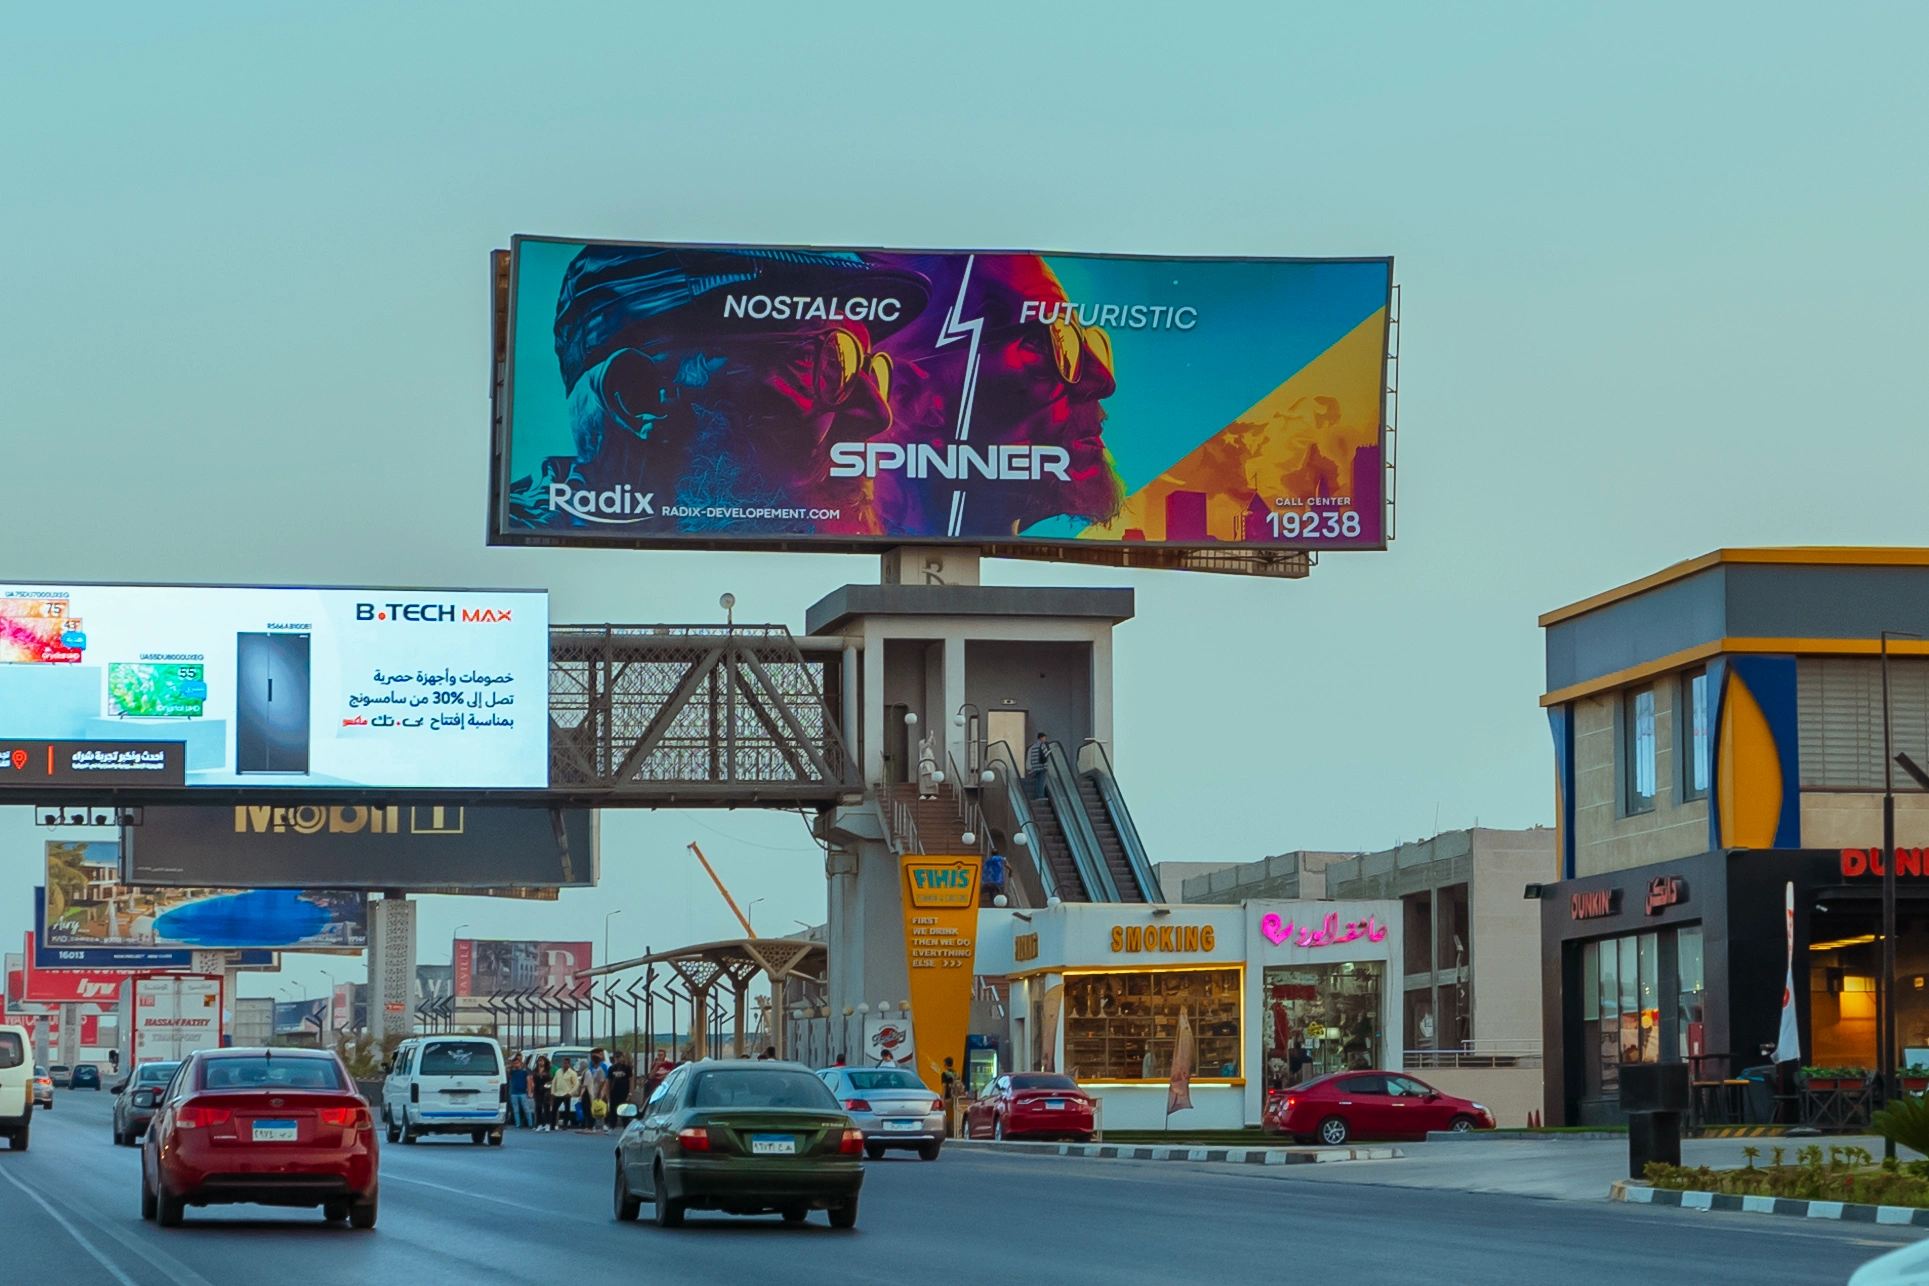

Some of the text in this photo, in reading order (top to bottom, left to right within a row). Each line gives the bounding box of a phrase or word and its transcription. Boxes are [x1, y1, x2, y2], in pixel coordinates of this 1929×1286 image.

[723, 295, 901, 322] NOSTALGIC
[1019, 300, 1198, 330] FUTURISTIC
[829, 442, 1071, 481] SPINNER
[547, 483, 655, 524] Radix
[1275, 497, 1351, 505] CALL CENTER
[661, 505, 841, 521] RADIX-DEVELOPEMENT.COM
[1265, 511, 1361, 538] 19238
[462, 608, 512, 622] MAX
[373, 667, 514, 686] خصومات وأجهزة حصرية
[349, 690, 514, 708] تصل إلى 30% من سامسونج
[467, 713, 514, 729] بمناسبة
[1842, 847, 1929, 876] DUN
[912, 917, 939, 925] FIRST
[1111, 925, 1215, 953] SMOKING
[912, 949, 972, 957] EVERYTHING
